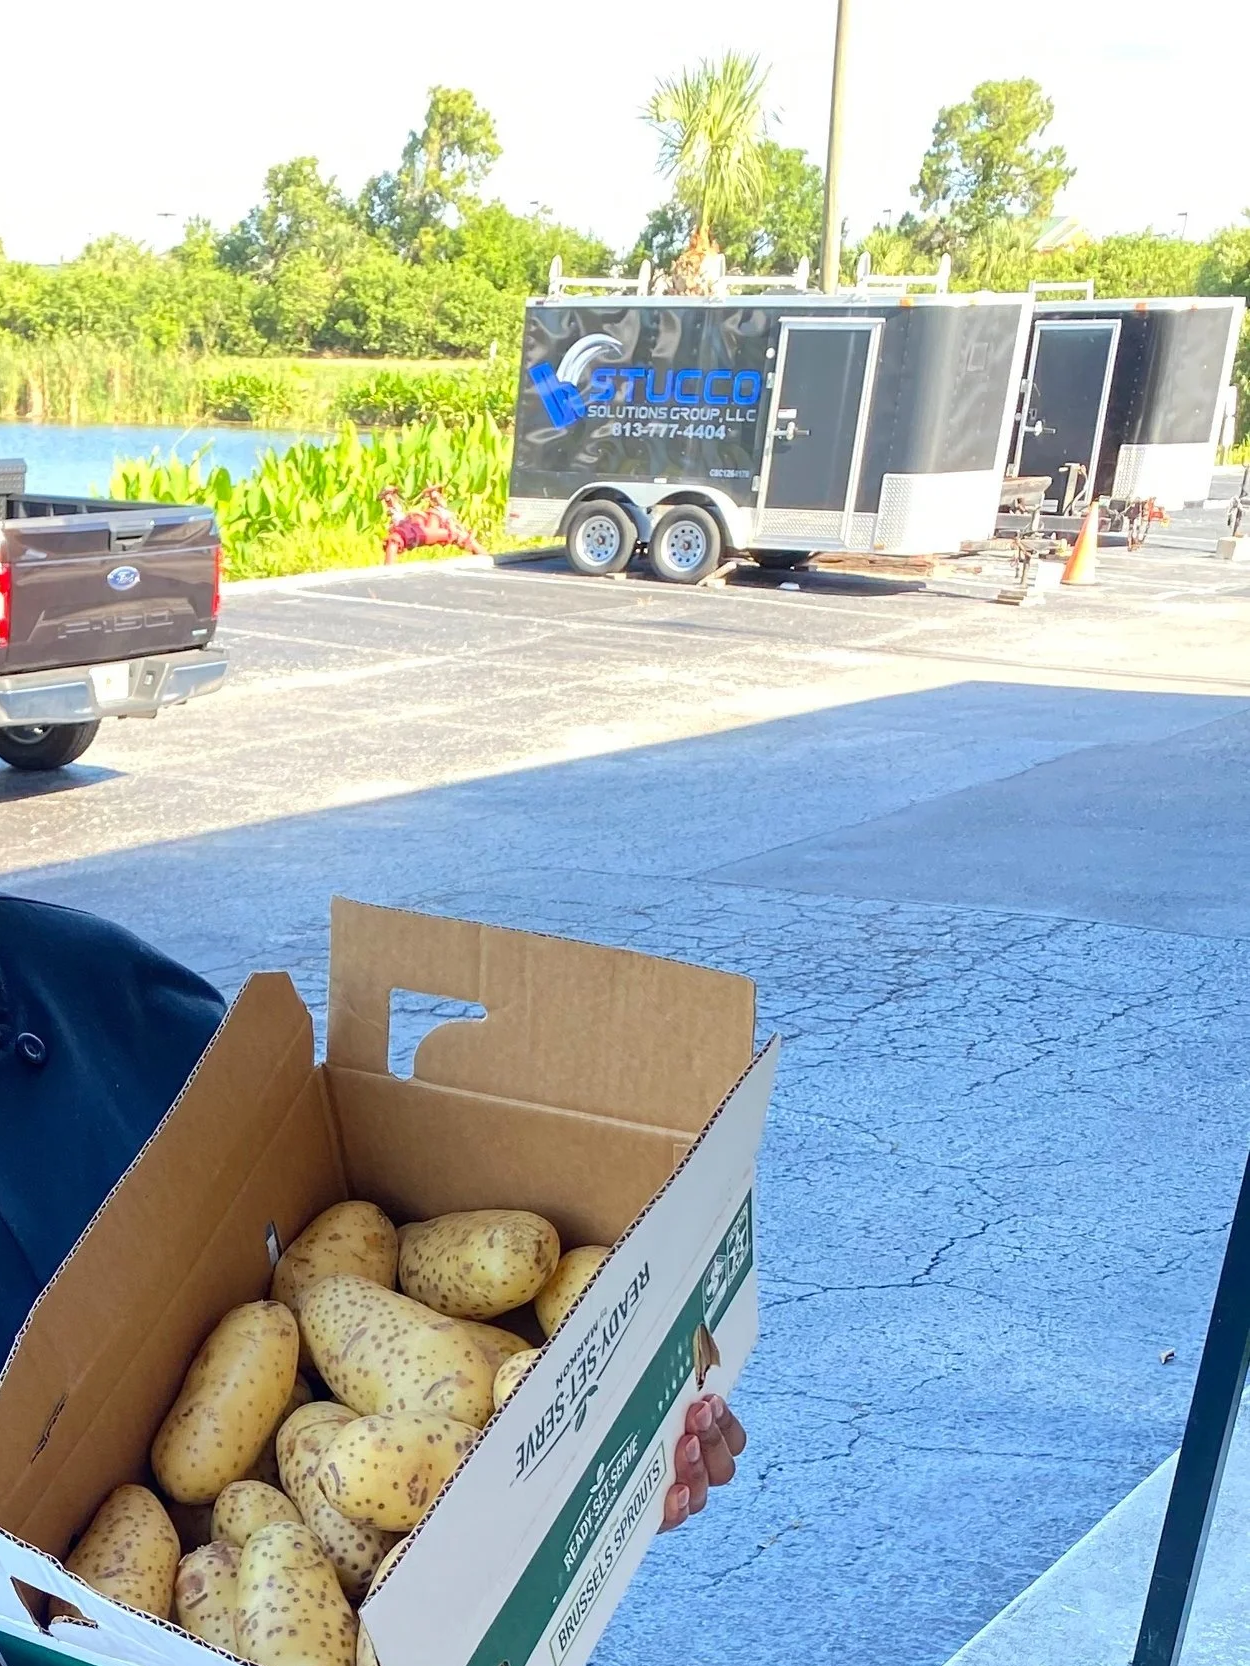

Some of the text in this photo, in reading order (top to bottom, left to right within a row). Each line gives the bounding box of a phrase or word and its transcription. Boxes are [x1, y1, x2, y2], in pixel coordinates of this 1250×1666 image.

[590, 368, 762, 406] STUCCO
[587, 405, 757, 423] SOLUTIONS GROUP, LLC
[612, 422, 726, 440] 813-777-4404
[556, 1317, 599, 1389] MARKON
[557, 1545, 613, 1653] BRUSSELS
[614, 1458, 660, 1553] SPROUTS
